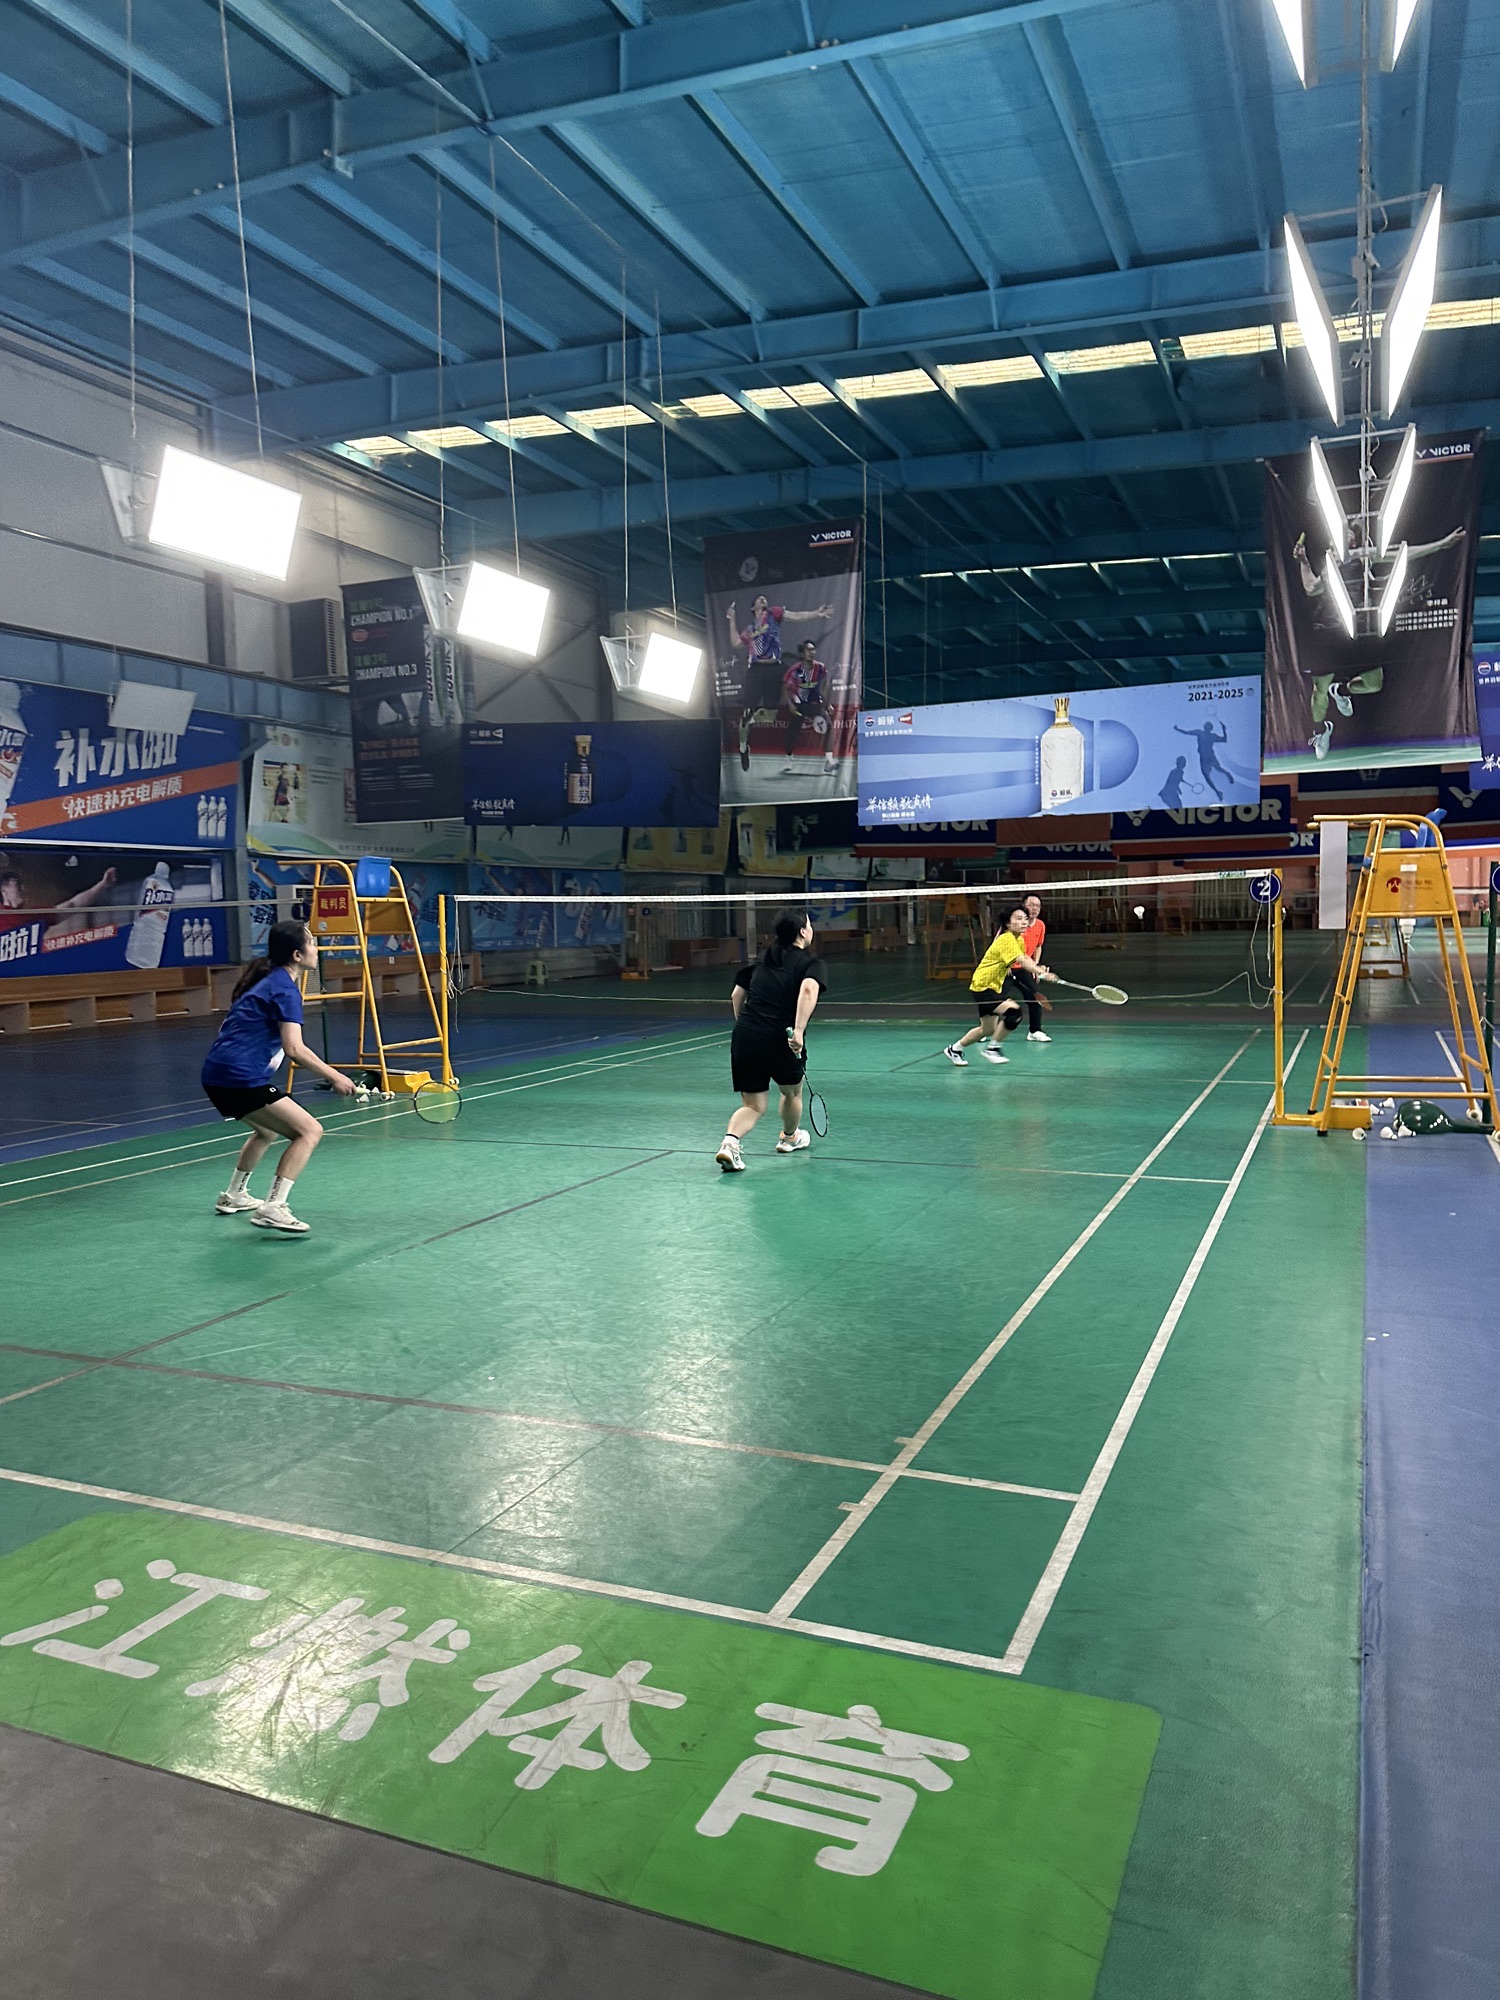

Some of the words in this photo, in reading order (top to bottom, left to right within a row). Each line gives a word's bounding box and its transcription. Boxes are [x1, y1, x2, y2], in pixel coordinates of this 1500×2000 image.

[1429, 443, 1471, 456] VICTOR
[821, 530, 852, 540] VICTOR
[350, 610, 393, 627] CHAMPION
[355, 665, 397, 681] CHAMPION
[398, 663, 418, 676] NO.3
[1188, 688, 1243, 702] 2021-2025
[54, 728, 177, 788] 补水啦
[67, 776, 182, 819] 快速补充电解质
[1166, 798, 1282, 825] VICTOR
[1256, 880, 1271, 896] 2
[320, 896, 347, 910] 裁判员
